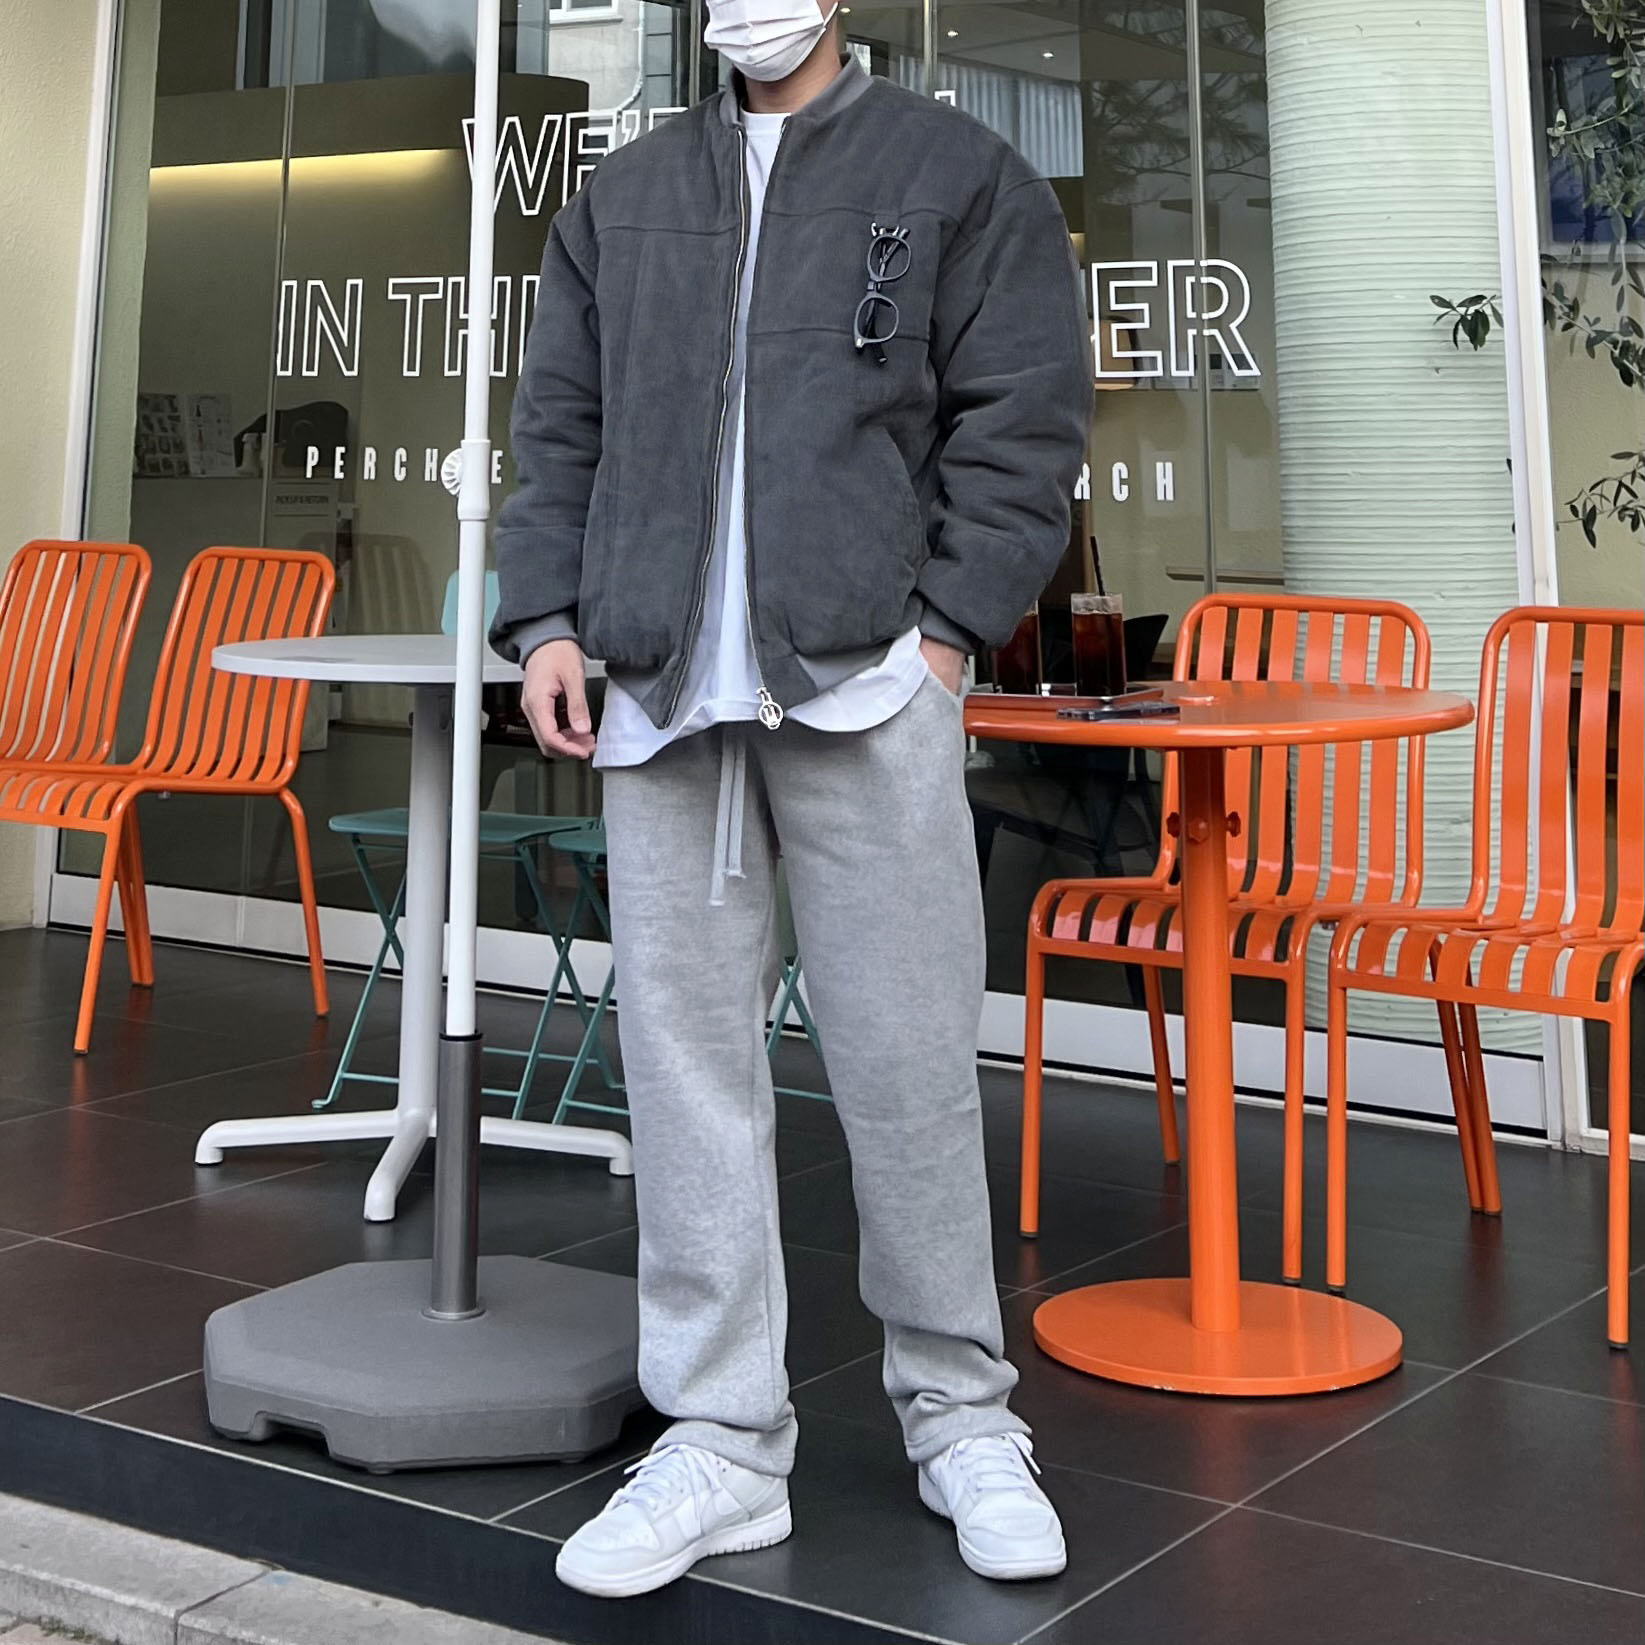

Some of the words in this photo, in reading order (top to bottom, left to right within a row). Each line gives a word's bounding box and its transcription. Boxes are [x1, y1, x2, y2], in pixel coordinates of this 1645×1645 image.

[461, 107, 689, 216] WE'
[276, 279, 363, 377] IN
[387, 274, 541, 378] THI
[1090, 258, 1262, 378] ER
[305, 446, 439, 482] PERCH
[1073, 461, 1175, 502] RCH
